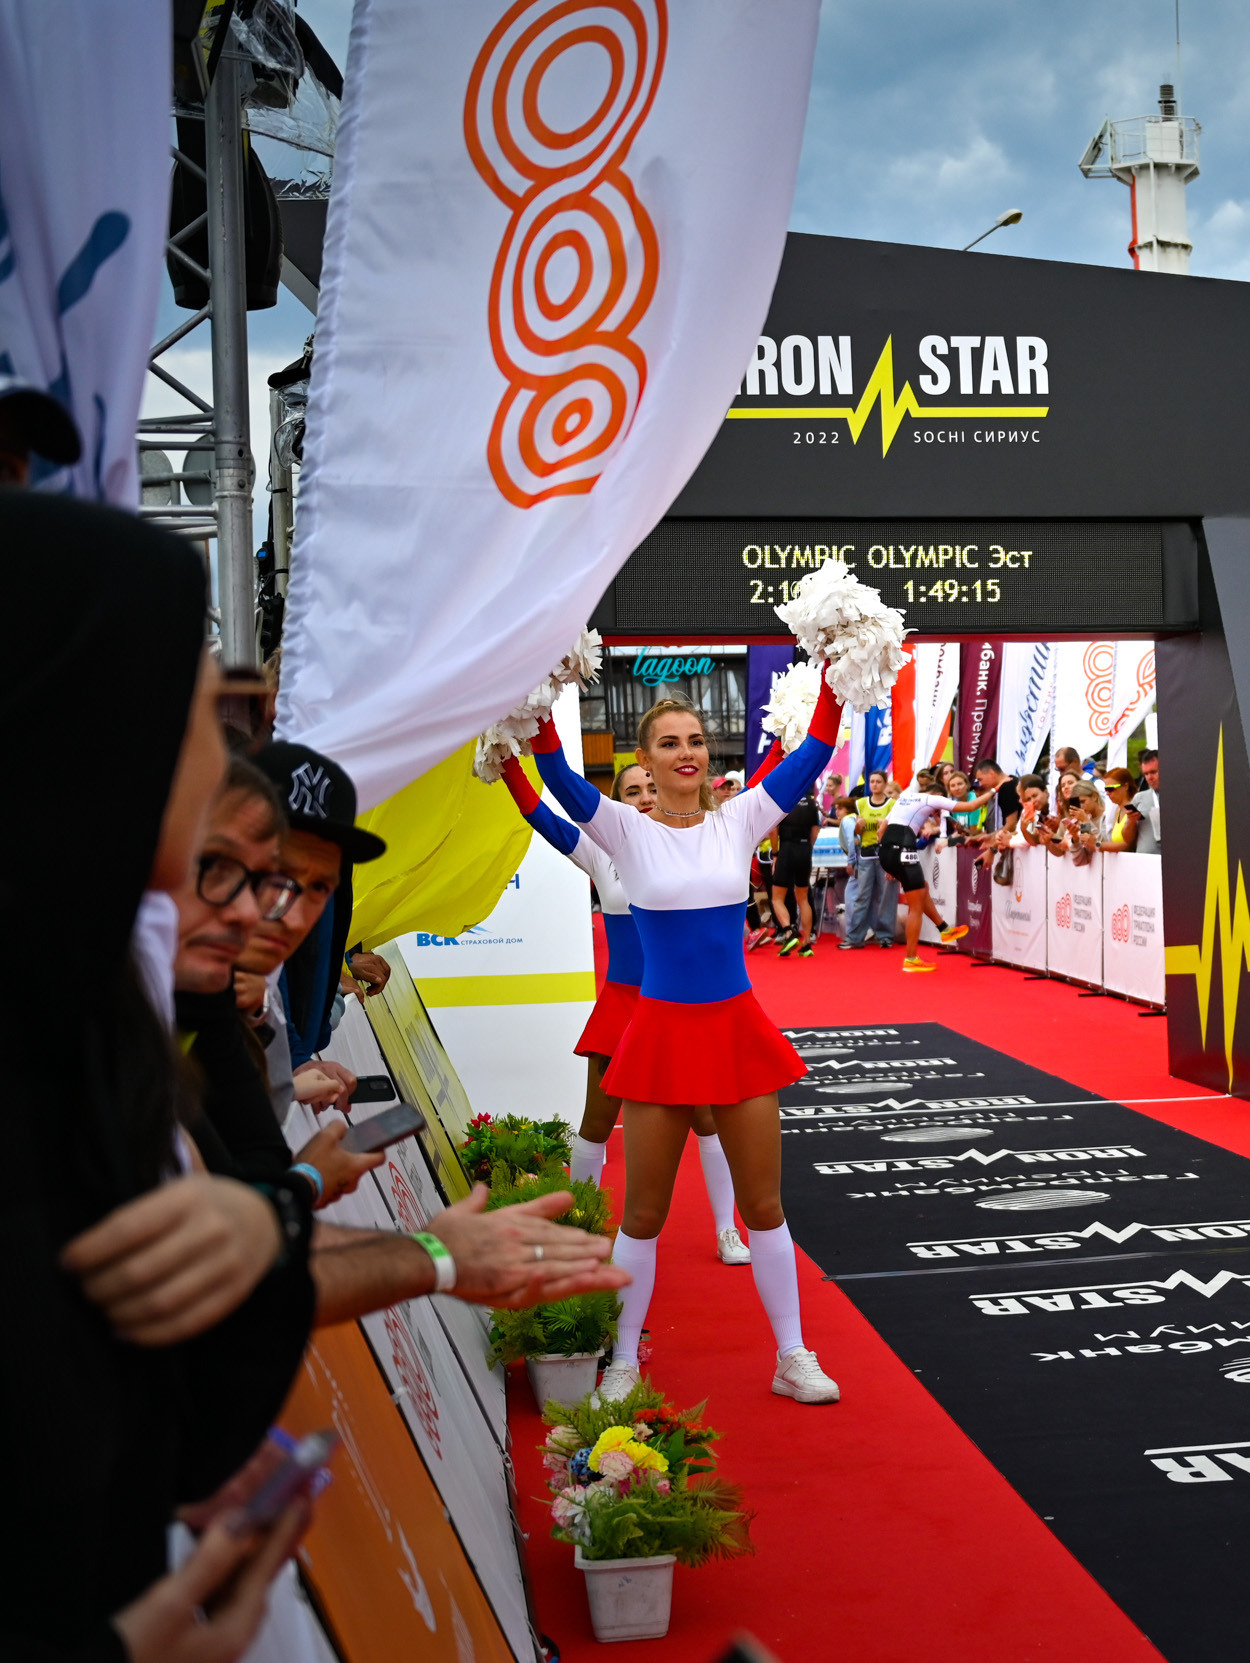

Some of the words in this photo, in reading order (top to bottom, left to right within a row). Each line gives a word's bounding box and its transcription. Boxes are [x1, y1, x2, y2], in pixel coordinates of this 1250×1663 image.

[918, 335, 1049, 395] STAR
[793, 432, 840, 445] 2022
[913, 431, 966, 443] SOCHI
[973, 430, 1041, 443] СИРИУС
[742, 545, 856, 568] OLYMPIC
[867, 545, 979, 568] OLYMPIC
[988, 546, 1033, 568] Эст
[903, 579, 1002, 603] 1:49:15
[633, 646, 716, 687] lagoon
[417, 933, 460, 947] ВСК
[461, 938, 504, 946] СТРАХОВОЙ
[505, 937, 523, 945] ДОМ
[925, 1097, 1037, 1110] IRON
[1013, 1147, 1147, 1163] IRON
[814, 1159, 955, 1175] STAR
[846, 1172, 1200, 1199] Газпромбанк
[894, 1168, 1129, 1188] Премиум
[908, 1236, 1082, 1259] STAR
[971, 1288, 1166, 1316] STAR
